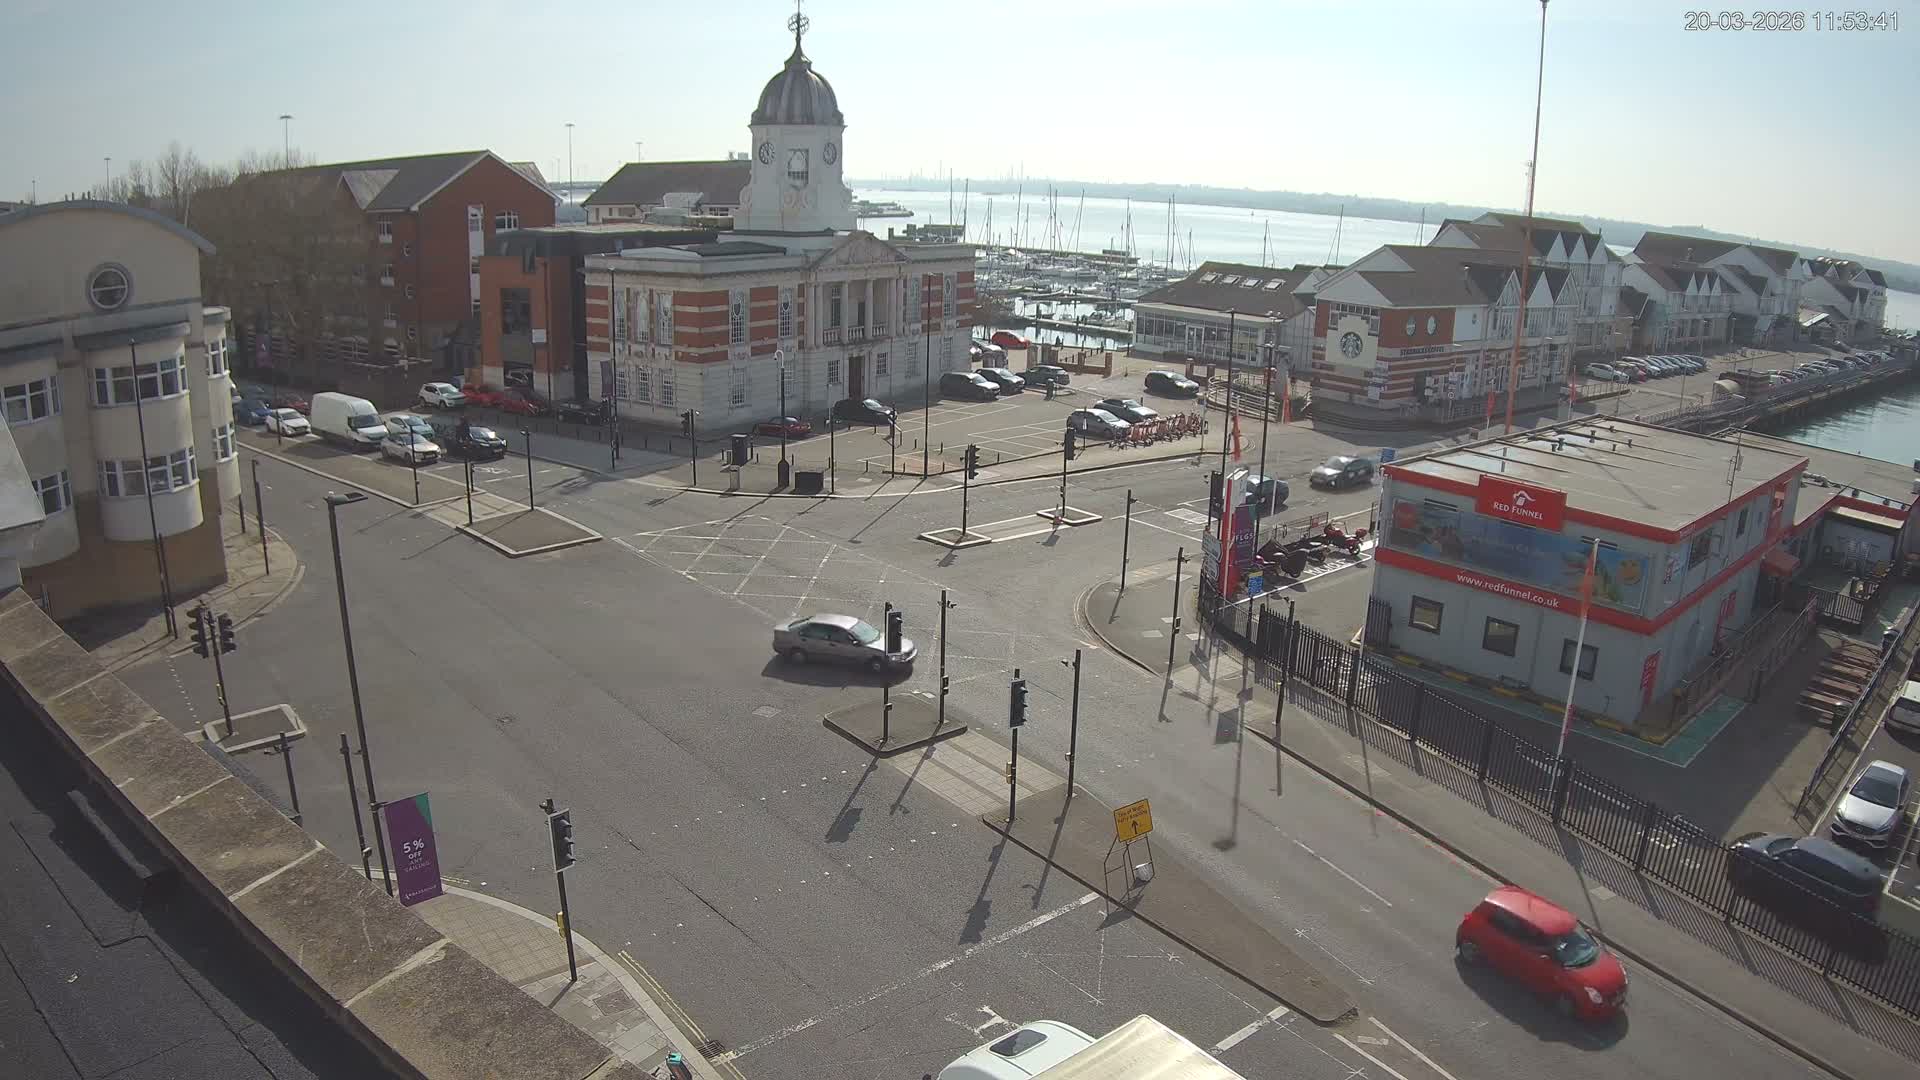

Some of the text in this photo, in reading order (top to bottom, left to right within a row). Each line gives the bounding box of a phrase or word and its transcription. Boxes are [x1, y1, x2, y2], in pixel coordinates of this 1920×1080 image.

[1493, 501, 1543, 520] RED FUNNEL
[1456, 573, 1560, 609] www.redfunnel.co.uk
[408, 851, 422, 860] OFF
